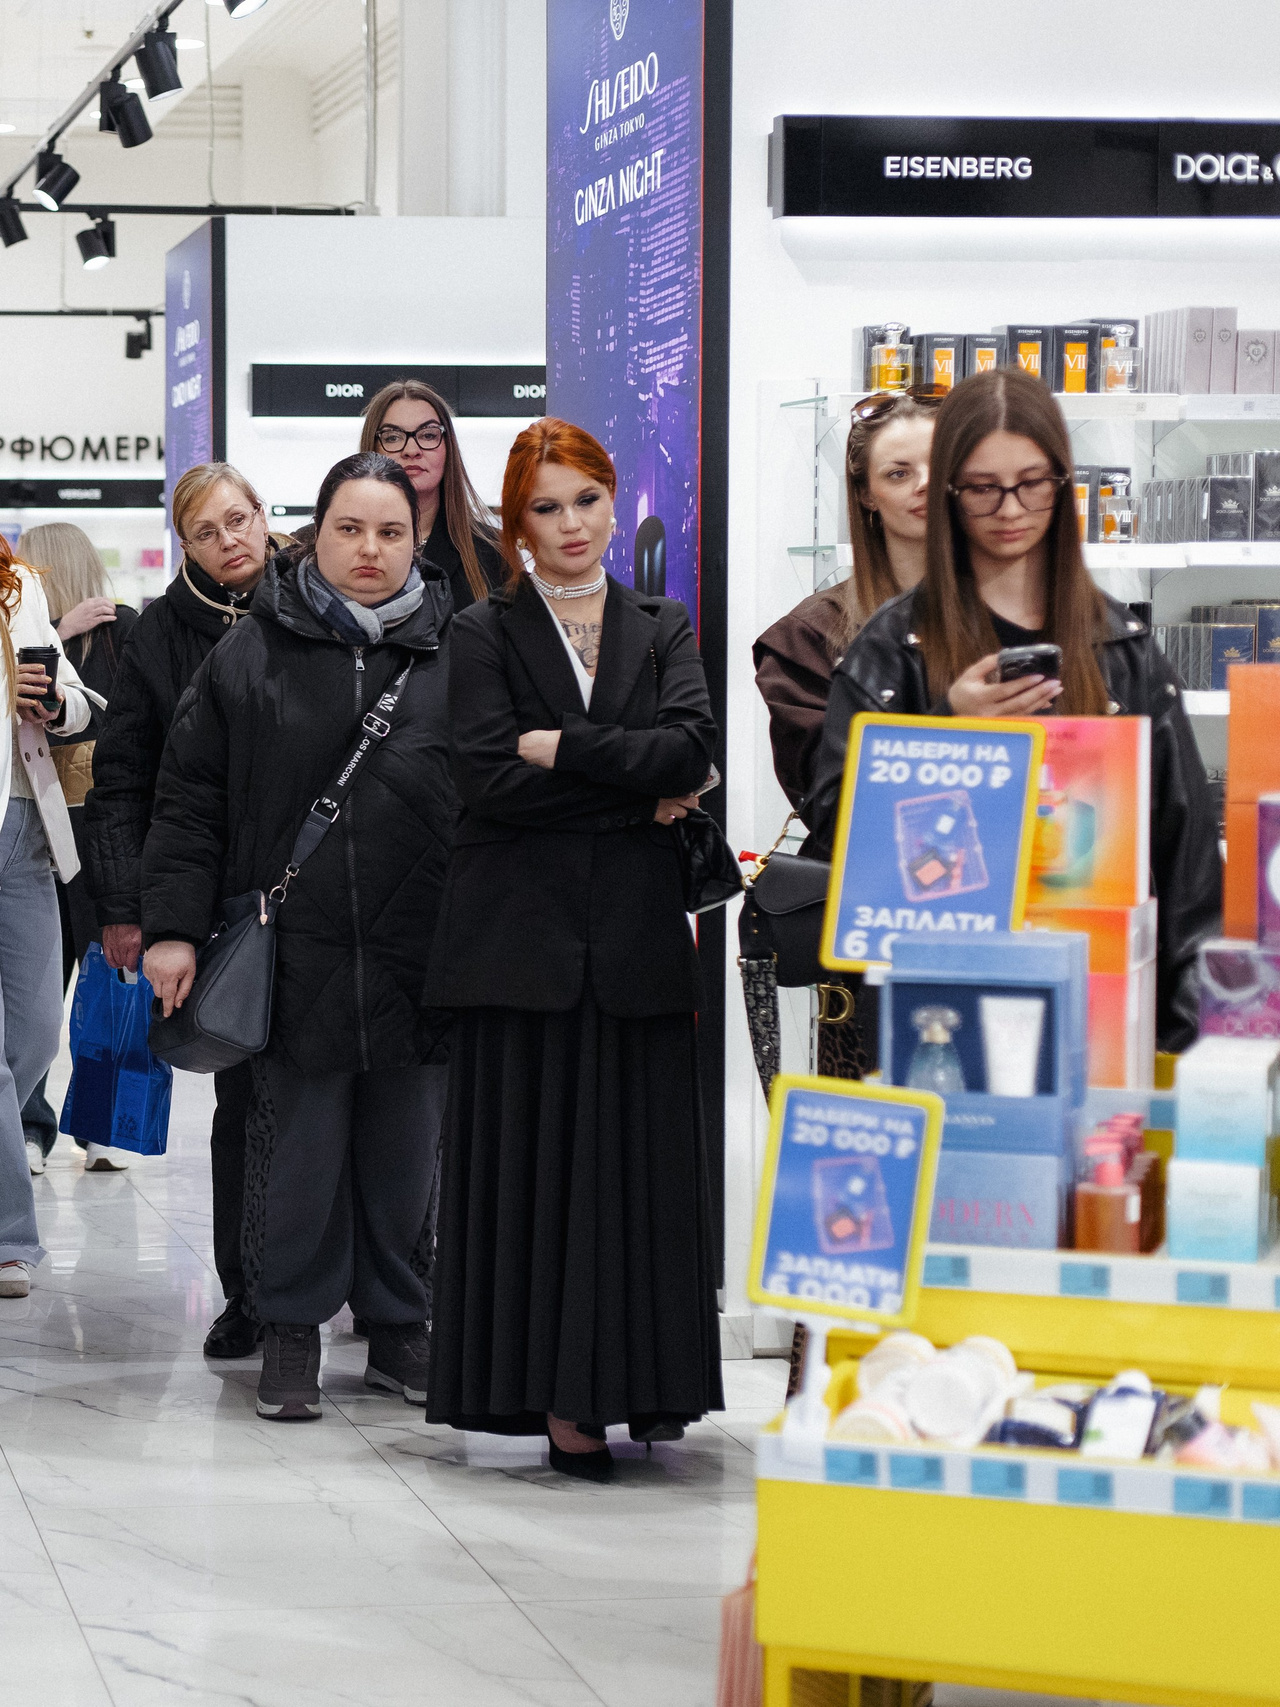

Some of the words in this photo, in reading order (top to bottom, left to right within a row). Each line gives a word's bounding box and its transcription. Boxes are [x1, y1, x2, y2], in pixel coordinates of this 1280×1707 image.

[579, 52, 659, 134] SHISEIDO
[594, 132, 618, 151] GINZA
[620, 113, 645, 138] TOKYO
[884, 156, 1033, 178] EISENBERG
[575, 174, 616, 226] GINZA
[619, 149, 665, 206] NIGHT
[1065, 354, 1086, 369] VII
[1115, 360, 1133, 374] VII
[326, 384, 364, 398] DIOR
[873, 739, 970, 761] НАБЕРИ
[974, 744, 1010, 763] НА
[337, 750, 365, 787] MARCONI
[869, 759, 911, 784] 20
[917, 762, 983, 788] 000
[854, 905, 996, 932] ЗАПЛАТИ
[843, 930, 869, 958] 6
[792, 1121, 830, 1146] 20
[833, 1131, 892, 1155] 000
[777, 1251, 900, 1287] ЗАПЛАТИ
